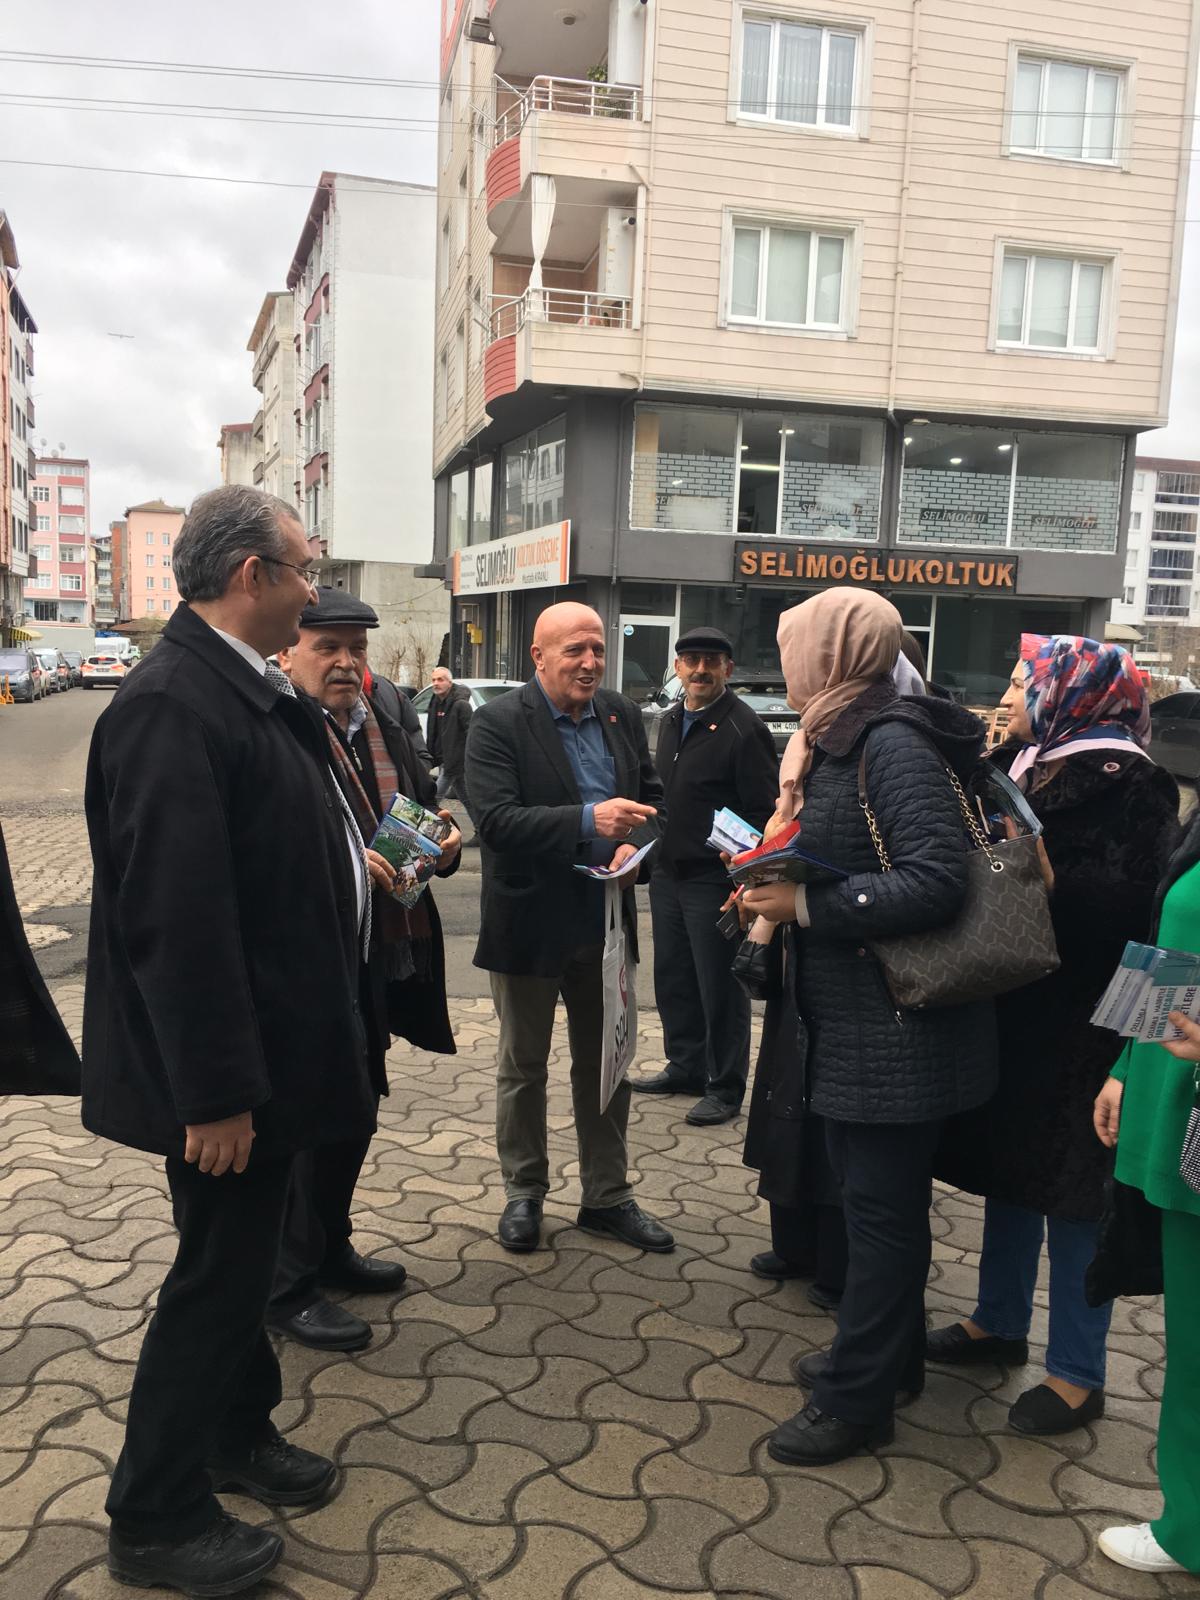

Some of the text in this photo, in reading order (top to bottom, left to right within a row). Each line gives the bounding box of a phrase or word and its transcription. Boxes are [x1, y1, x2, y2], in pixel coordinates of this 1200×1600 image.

[476, 543, 516, 587] SELİMOĞLU
[537, 536, 560, 565] DÖŞEME
[739, 546, 1015, 588] SELİMOĞLUKOLTUK
